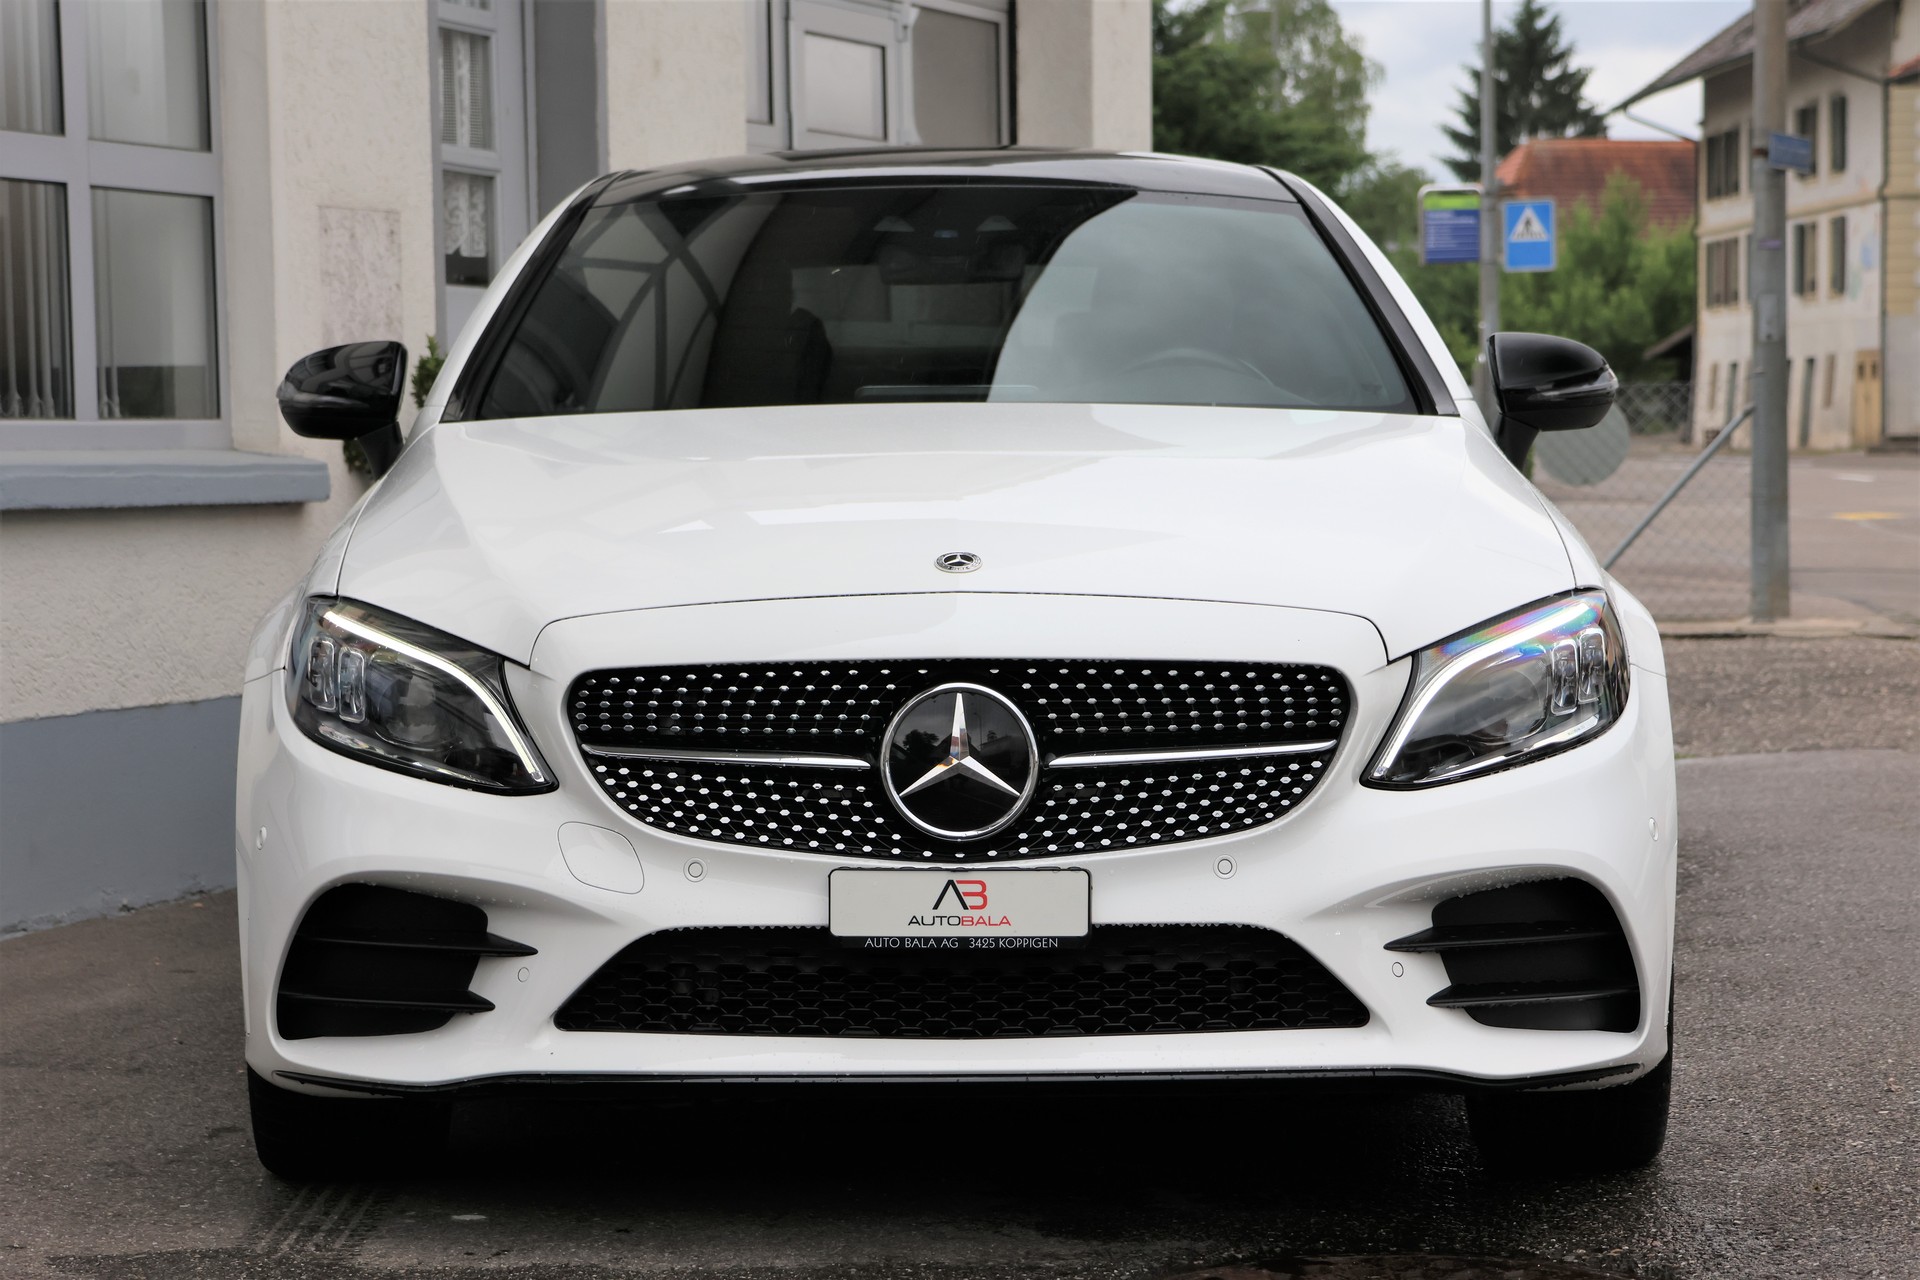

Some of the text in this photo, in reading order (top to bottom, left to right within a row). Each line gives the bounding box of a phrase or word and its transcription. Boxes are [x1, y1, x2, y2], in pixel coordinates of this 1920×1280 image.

[908, 915, 1012, 927] AUTOBALA
[864, 937, 1058, 949] AUTO BALA AG 3425 KOPPIGEN
